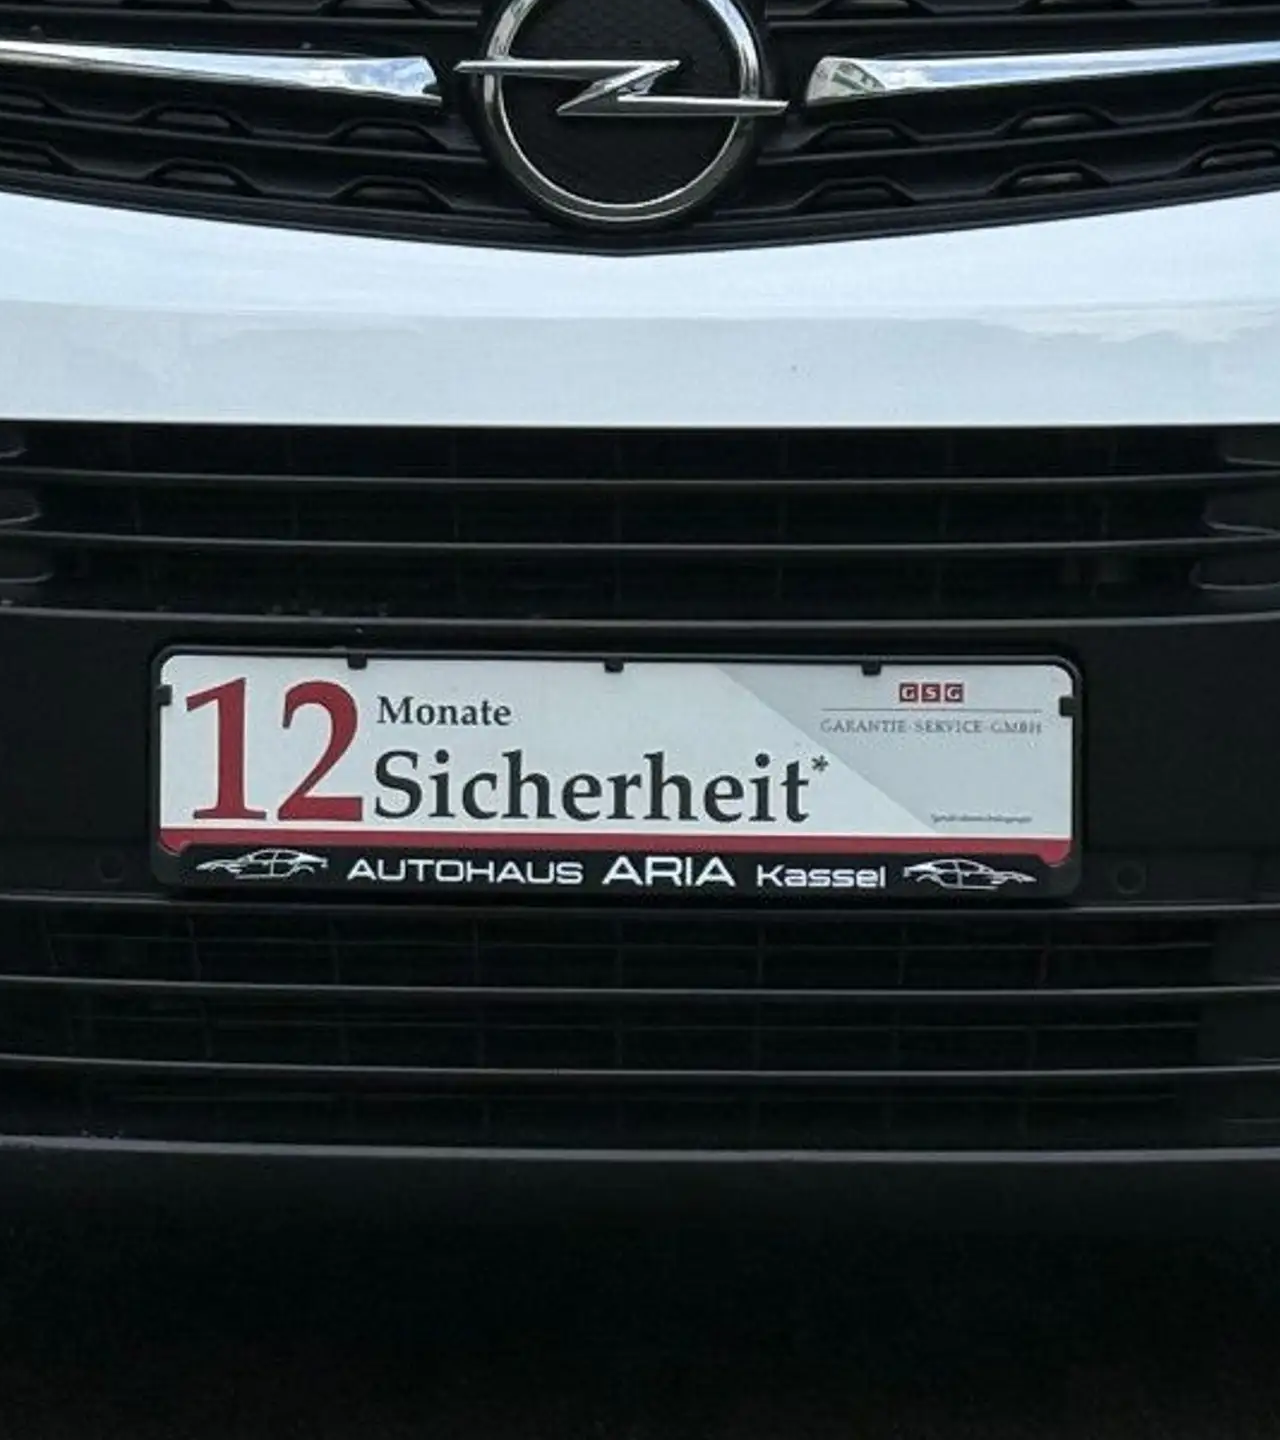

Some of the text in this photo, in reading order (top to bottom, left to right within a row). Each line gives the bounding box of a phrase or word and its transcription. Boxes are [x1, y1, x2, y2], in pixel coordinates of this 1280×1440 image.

[900, 683, 963, 702] GSG
[377, 695, 511, 726] Monate
[186, 677, 363, 821] 12
[347, 855, 886, 888] AUTOHAUS ARIA Kassel
